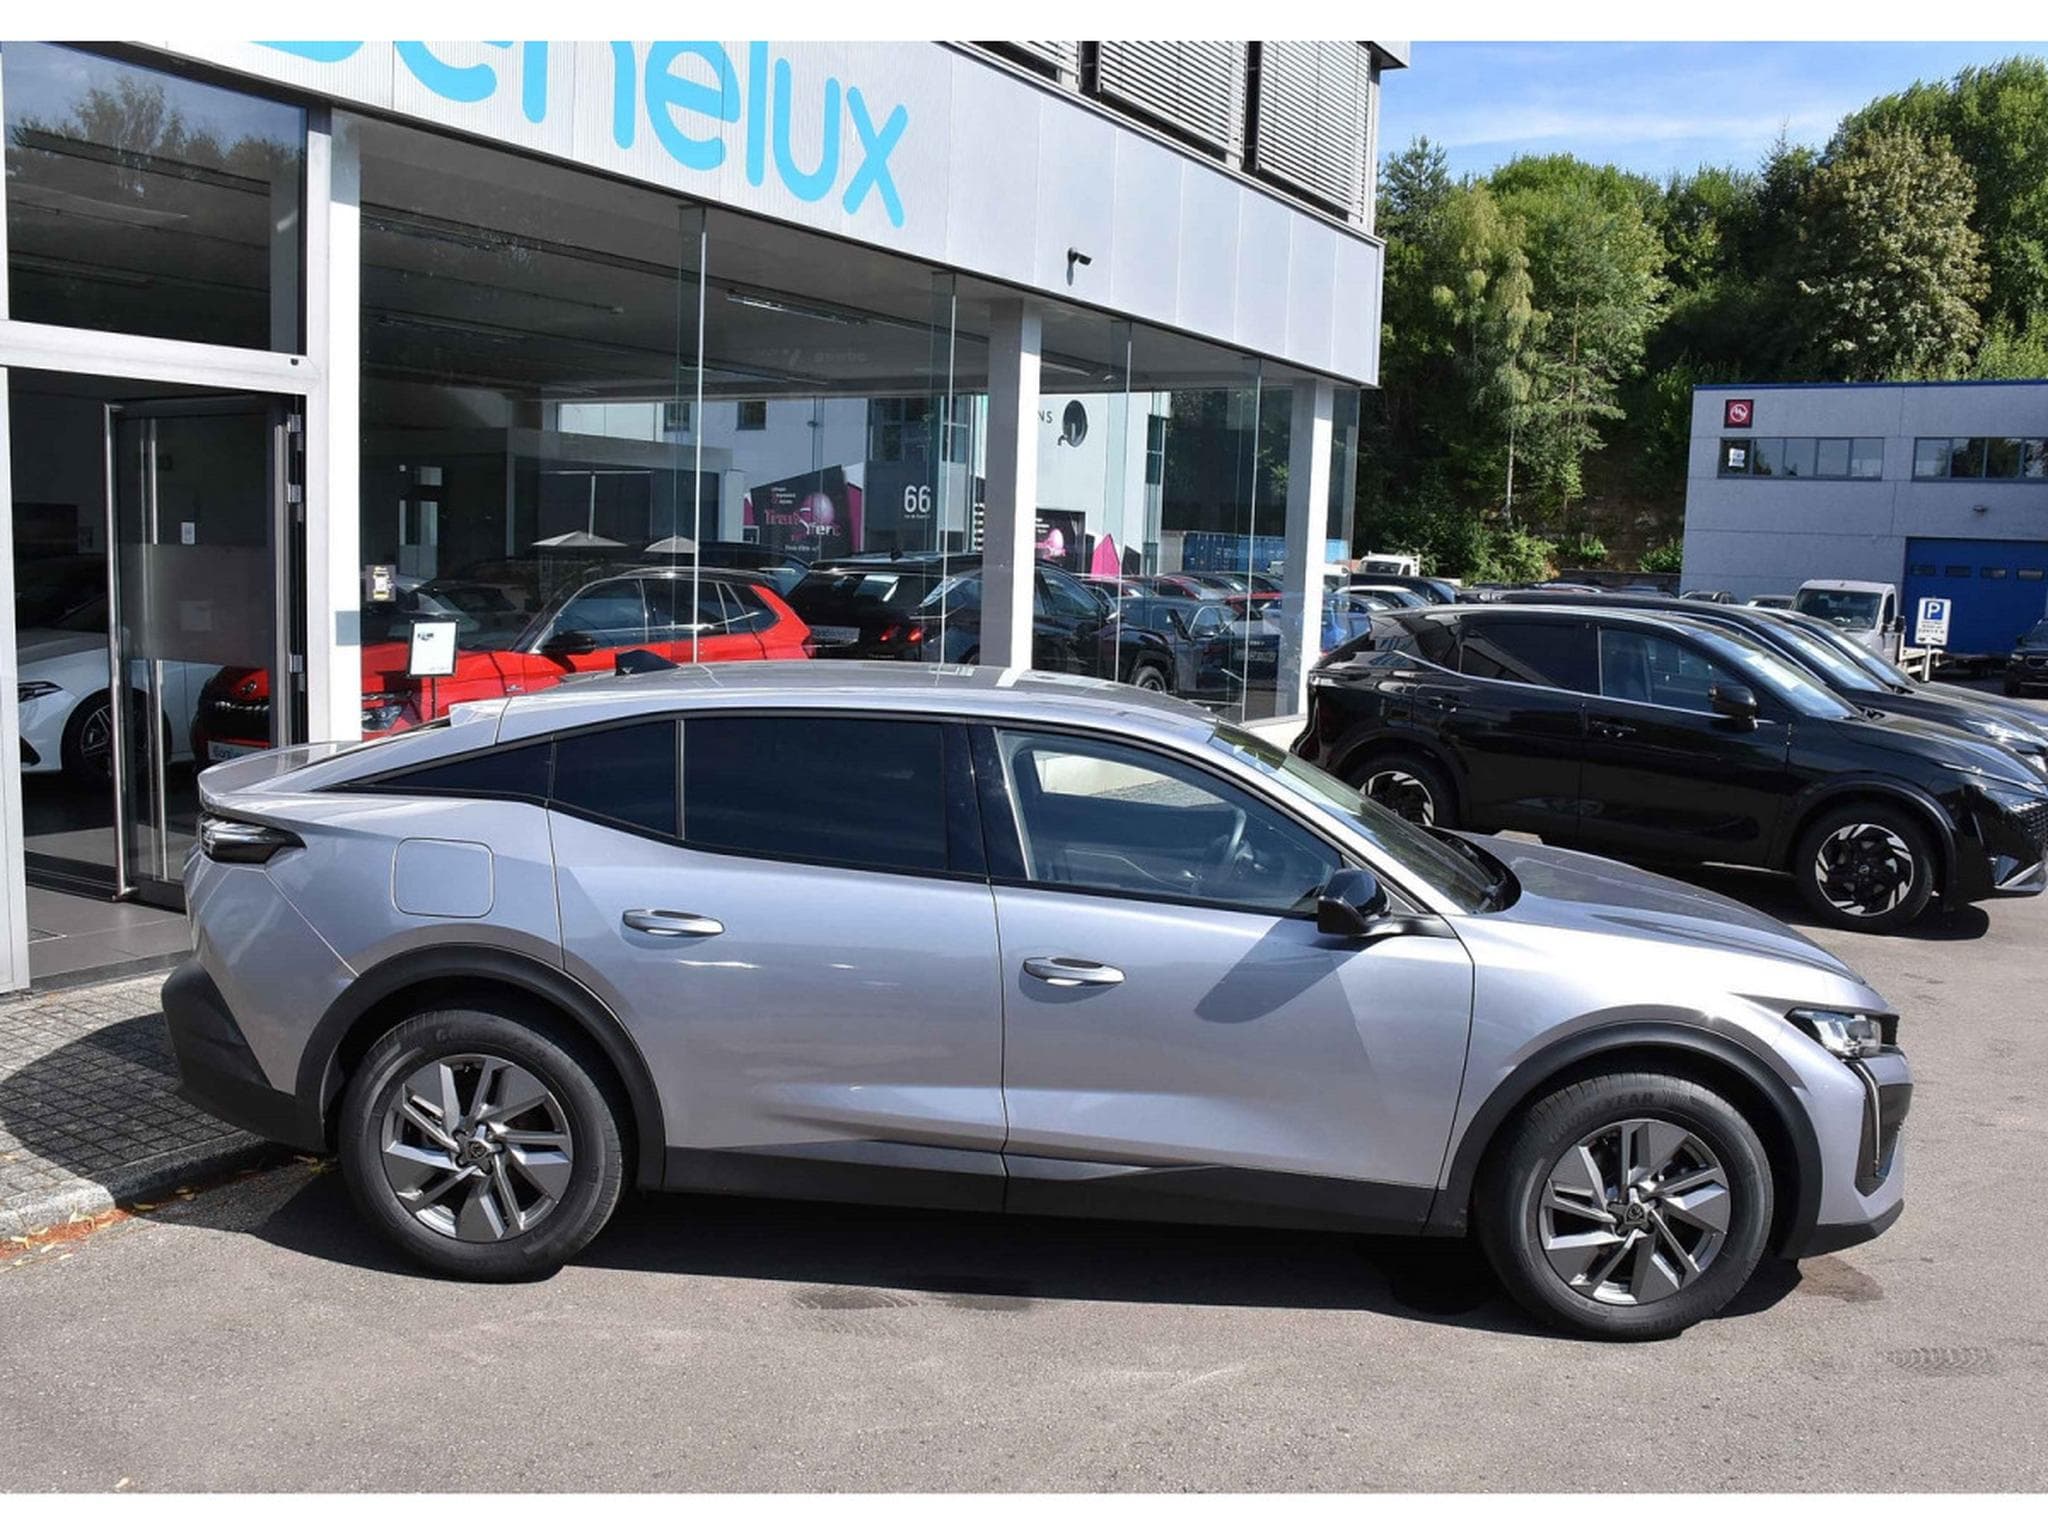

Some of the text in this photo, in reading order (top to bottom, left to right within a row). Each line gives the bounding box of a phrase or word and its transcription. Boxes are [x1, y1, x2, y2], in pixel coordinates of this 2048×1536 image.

[252, 41, 909, 228] nelux
[904, 485, 931, 513] 66
[1927, 602, 1941, 619] P
